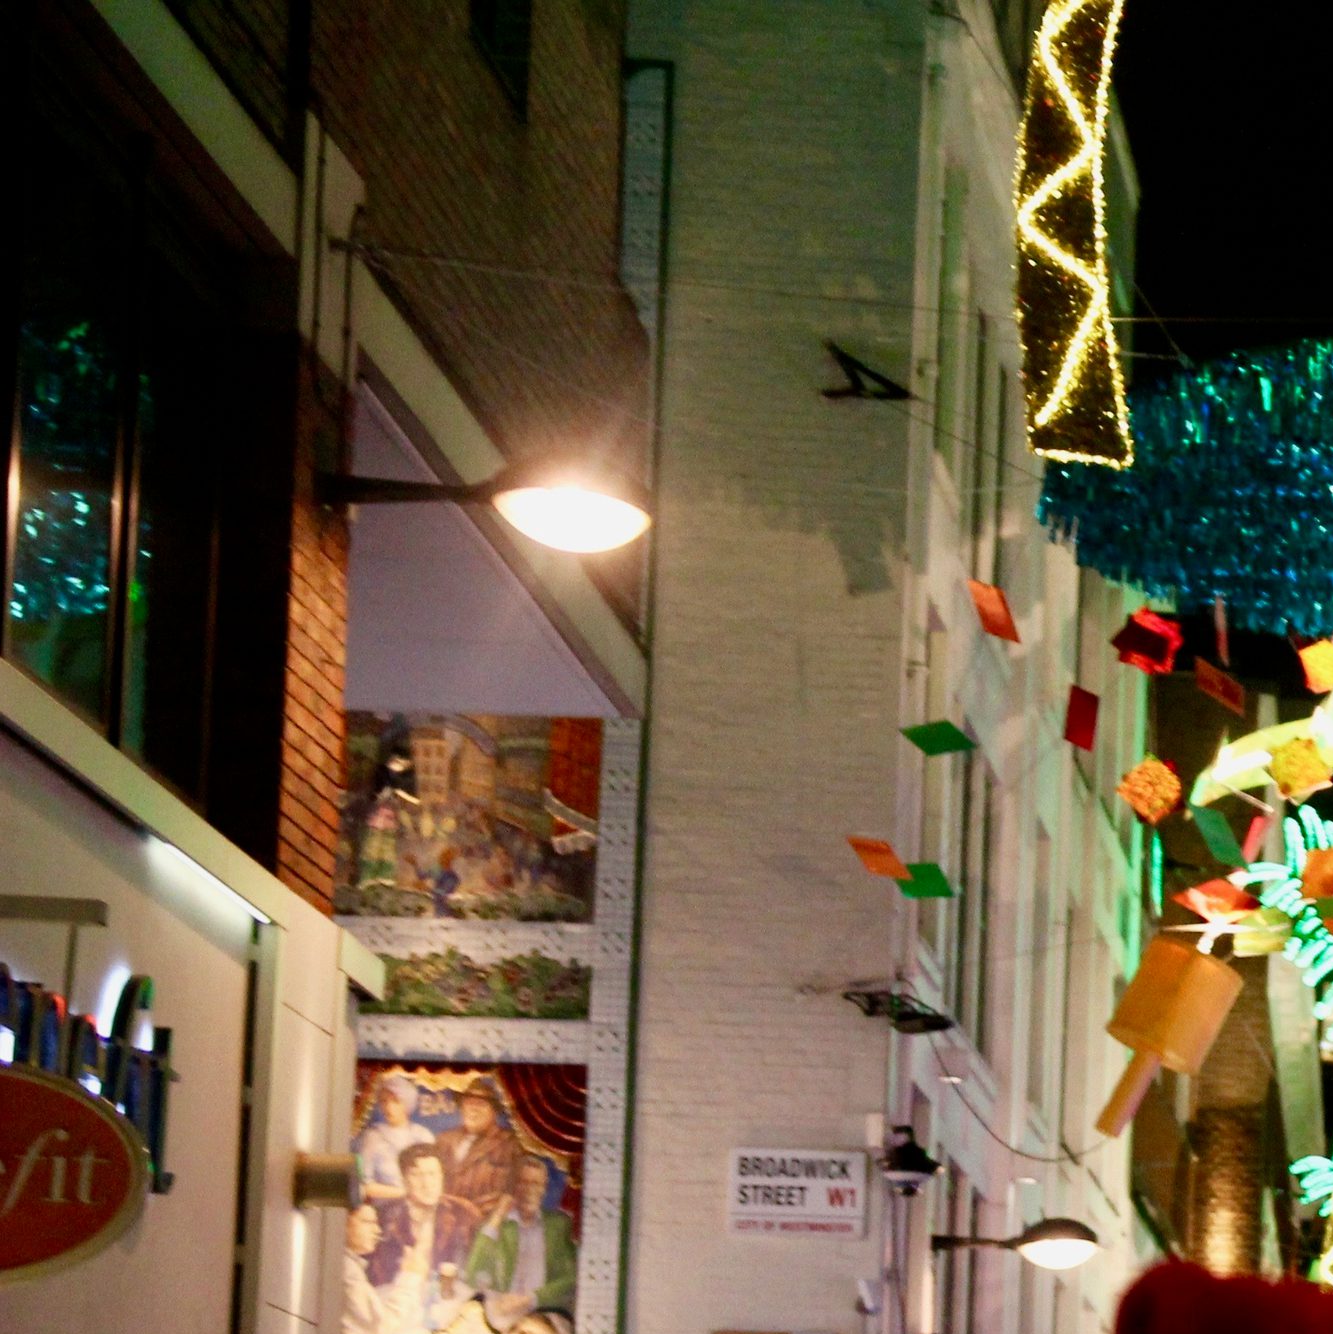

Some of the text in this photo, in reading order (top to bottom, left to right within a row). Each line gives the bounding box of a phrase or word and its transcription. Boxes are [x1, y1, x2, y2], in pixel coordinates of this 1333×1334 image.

[0, 1127, 113, 1215] fit
[737, 1156, 851, 1180] BROADWICK
[738, 1185, 857, 1209] STREET W1
